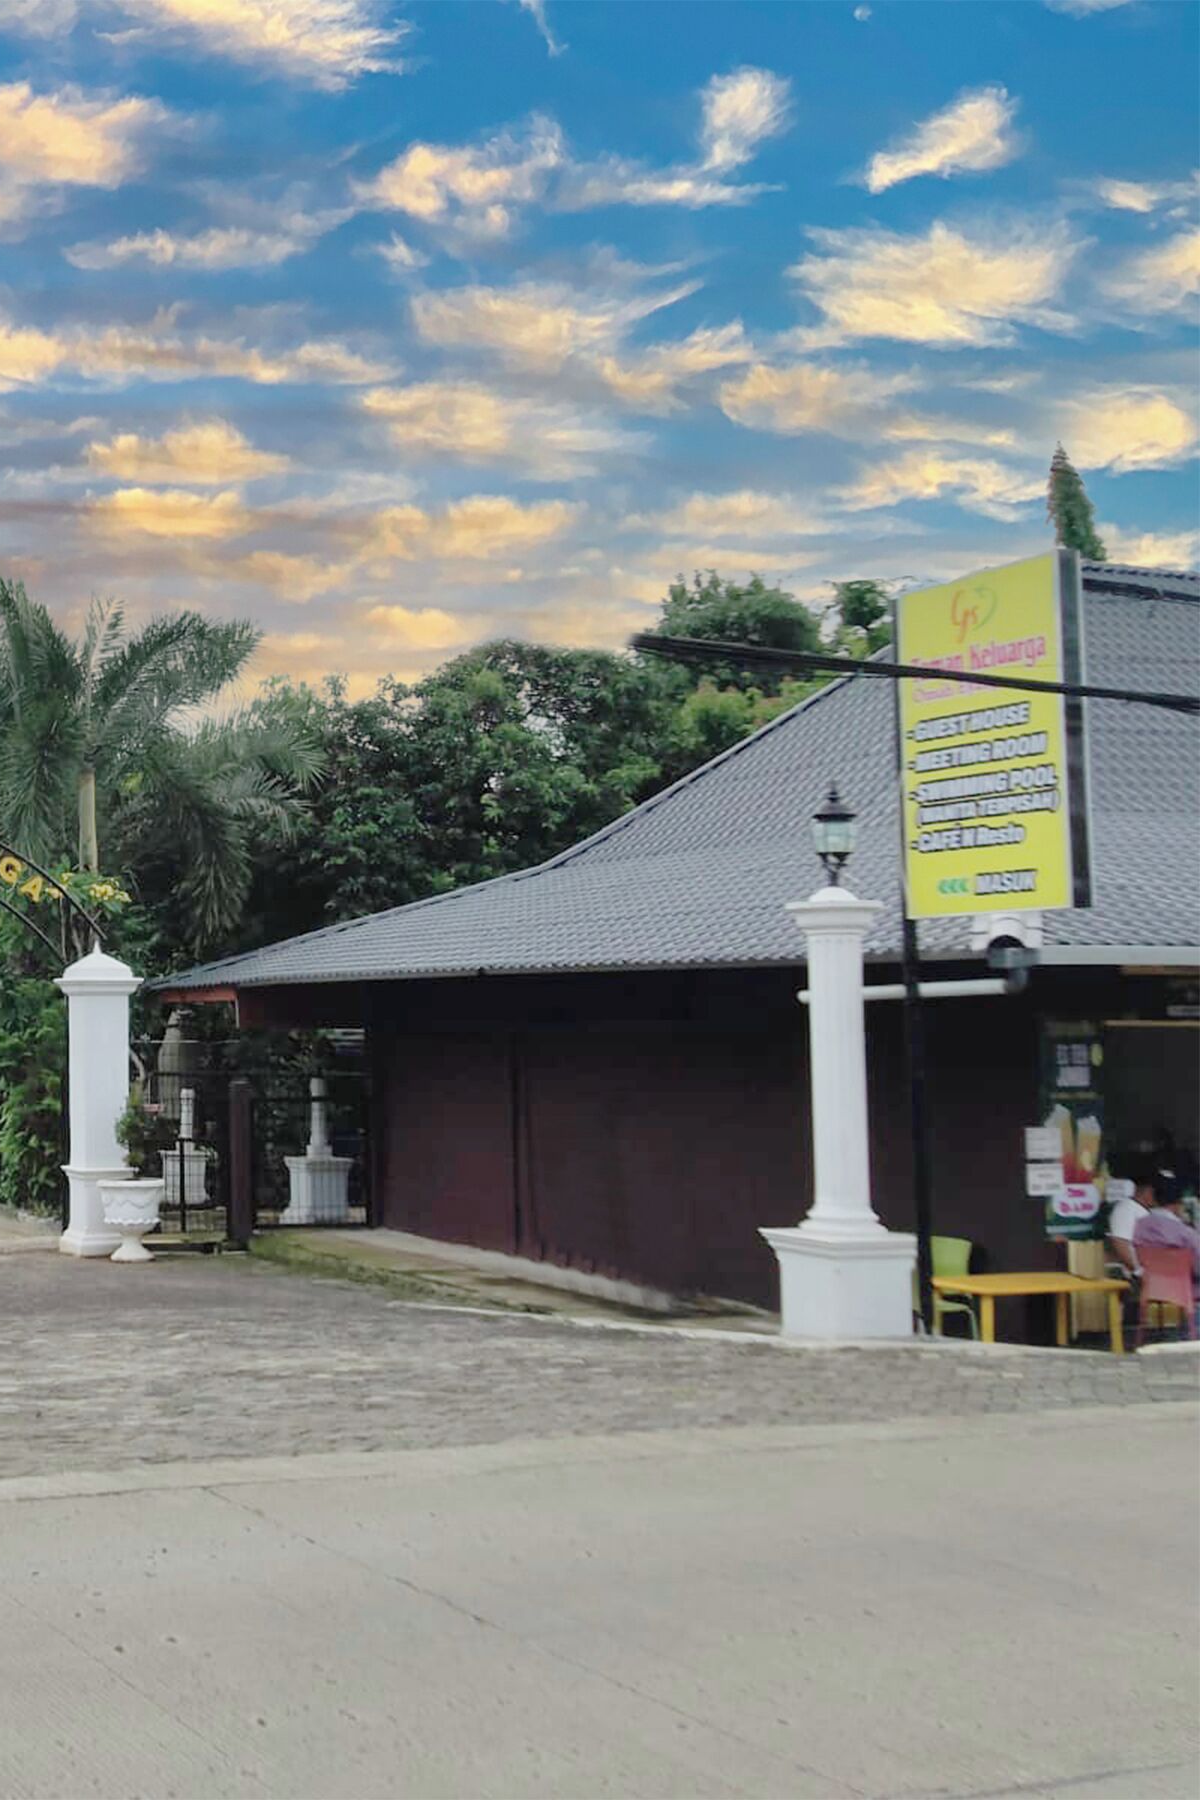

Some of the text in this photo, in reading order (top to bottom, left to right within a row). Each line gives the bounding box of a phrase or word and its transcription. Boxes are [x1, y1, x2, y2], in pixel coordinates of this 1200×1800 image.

[915, 701, 1031, 742] GUEST HOUSE
[915, 730, 1049, 773] MEETING ROOM
[916, 763, 1058, 803] SWIMMING POOL
[974, 868, 1038, 895] MASUK
